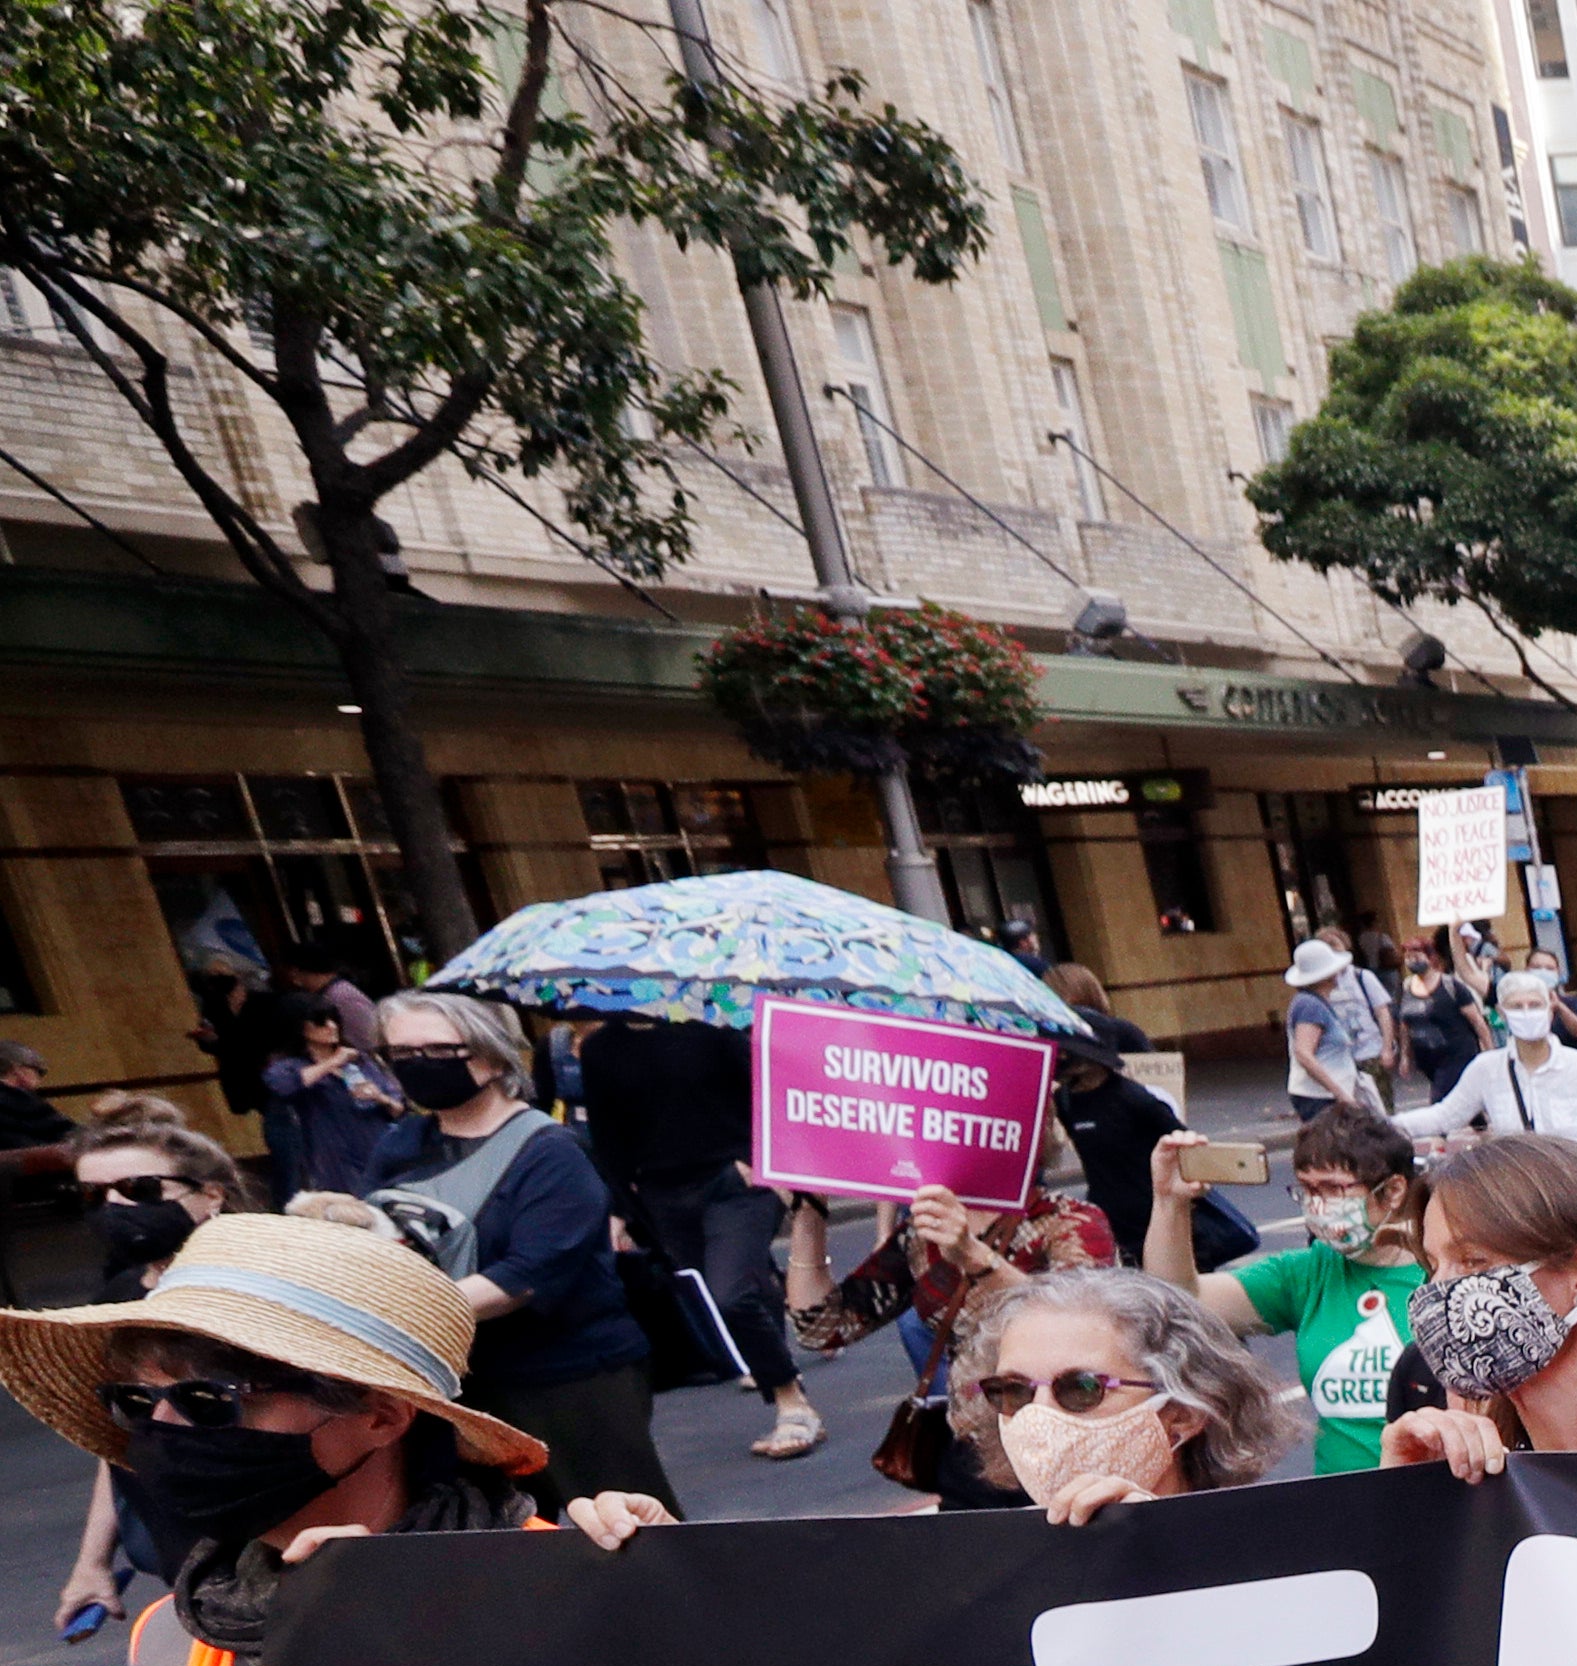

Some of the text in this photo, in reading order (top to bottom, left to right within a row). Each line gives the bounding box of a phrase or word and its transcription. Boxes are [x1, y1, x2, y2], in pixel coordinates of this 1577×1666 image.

[1018, 780, 1130, 807] WAGERING
[1424, 793, 1500, 817] NO JUSTICE
[1424, 819, 1497, 847] NO PEACE
[1426, 850, 1448, 870] NO
[1426, 861, 1498, 889] ATTORNEY
[1425, 886, 1495, 913] GENERAL
[823, 1044, 989, 1100] SURVIVORS
[786, 1087, 1023, 1153] DESERVE BETTER
[1350, 1347, 1391, 1373] THE
[1320, 1377, 1390, 1405] GREE
